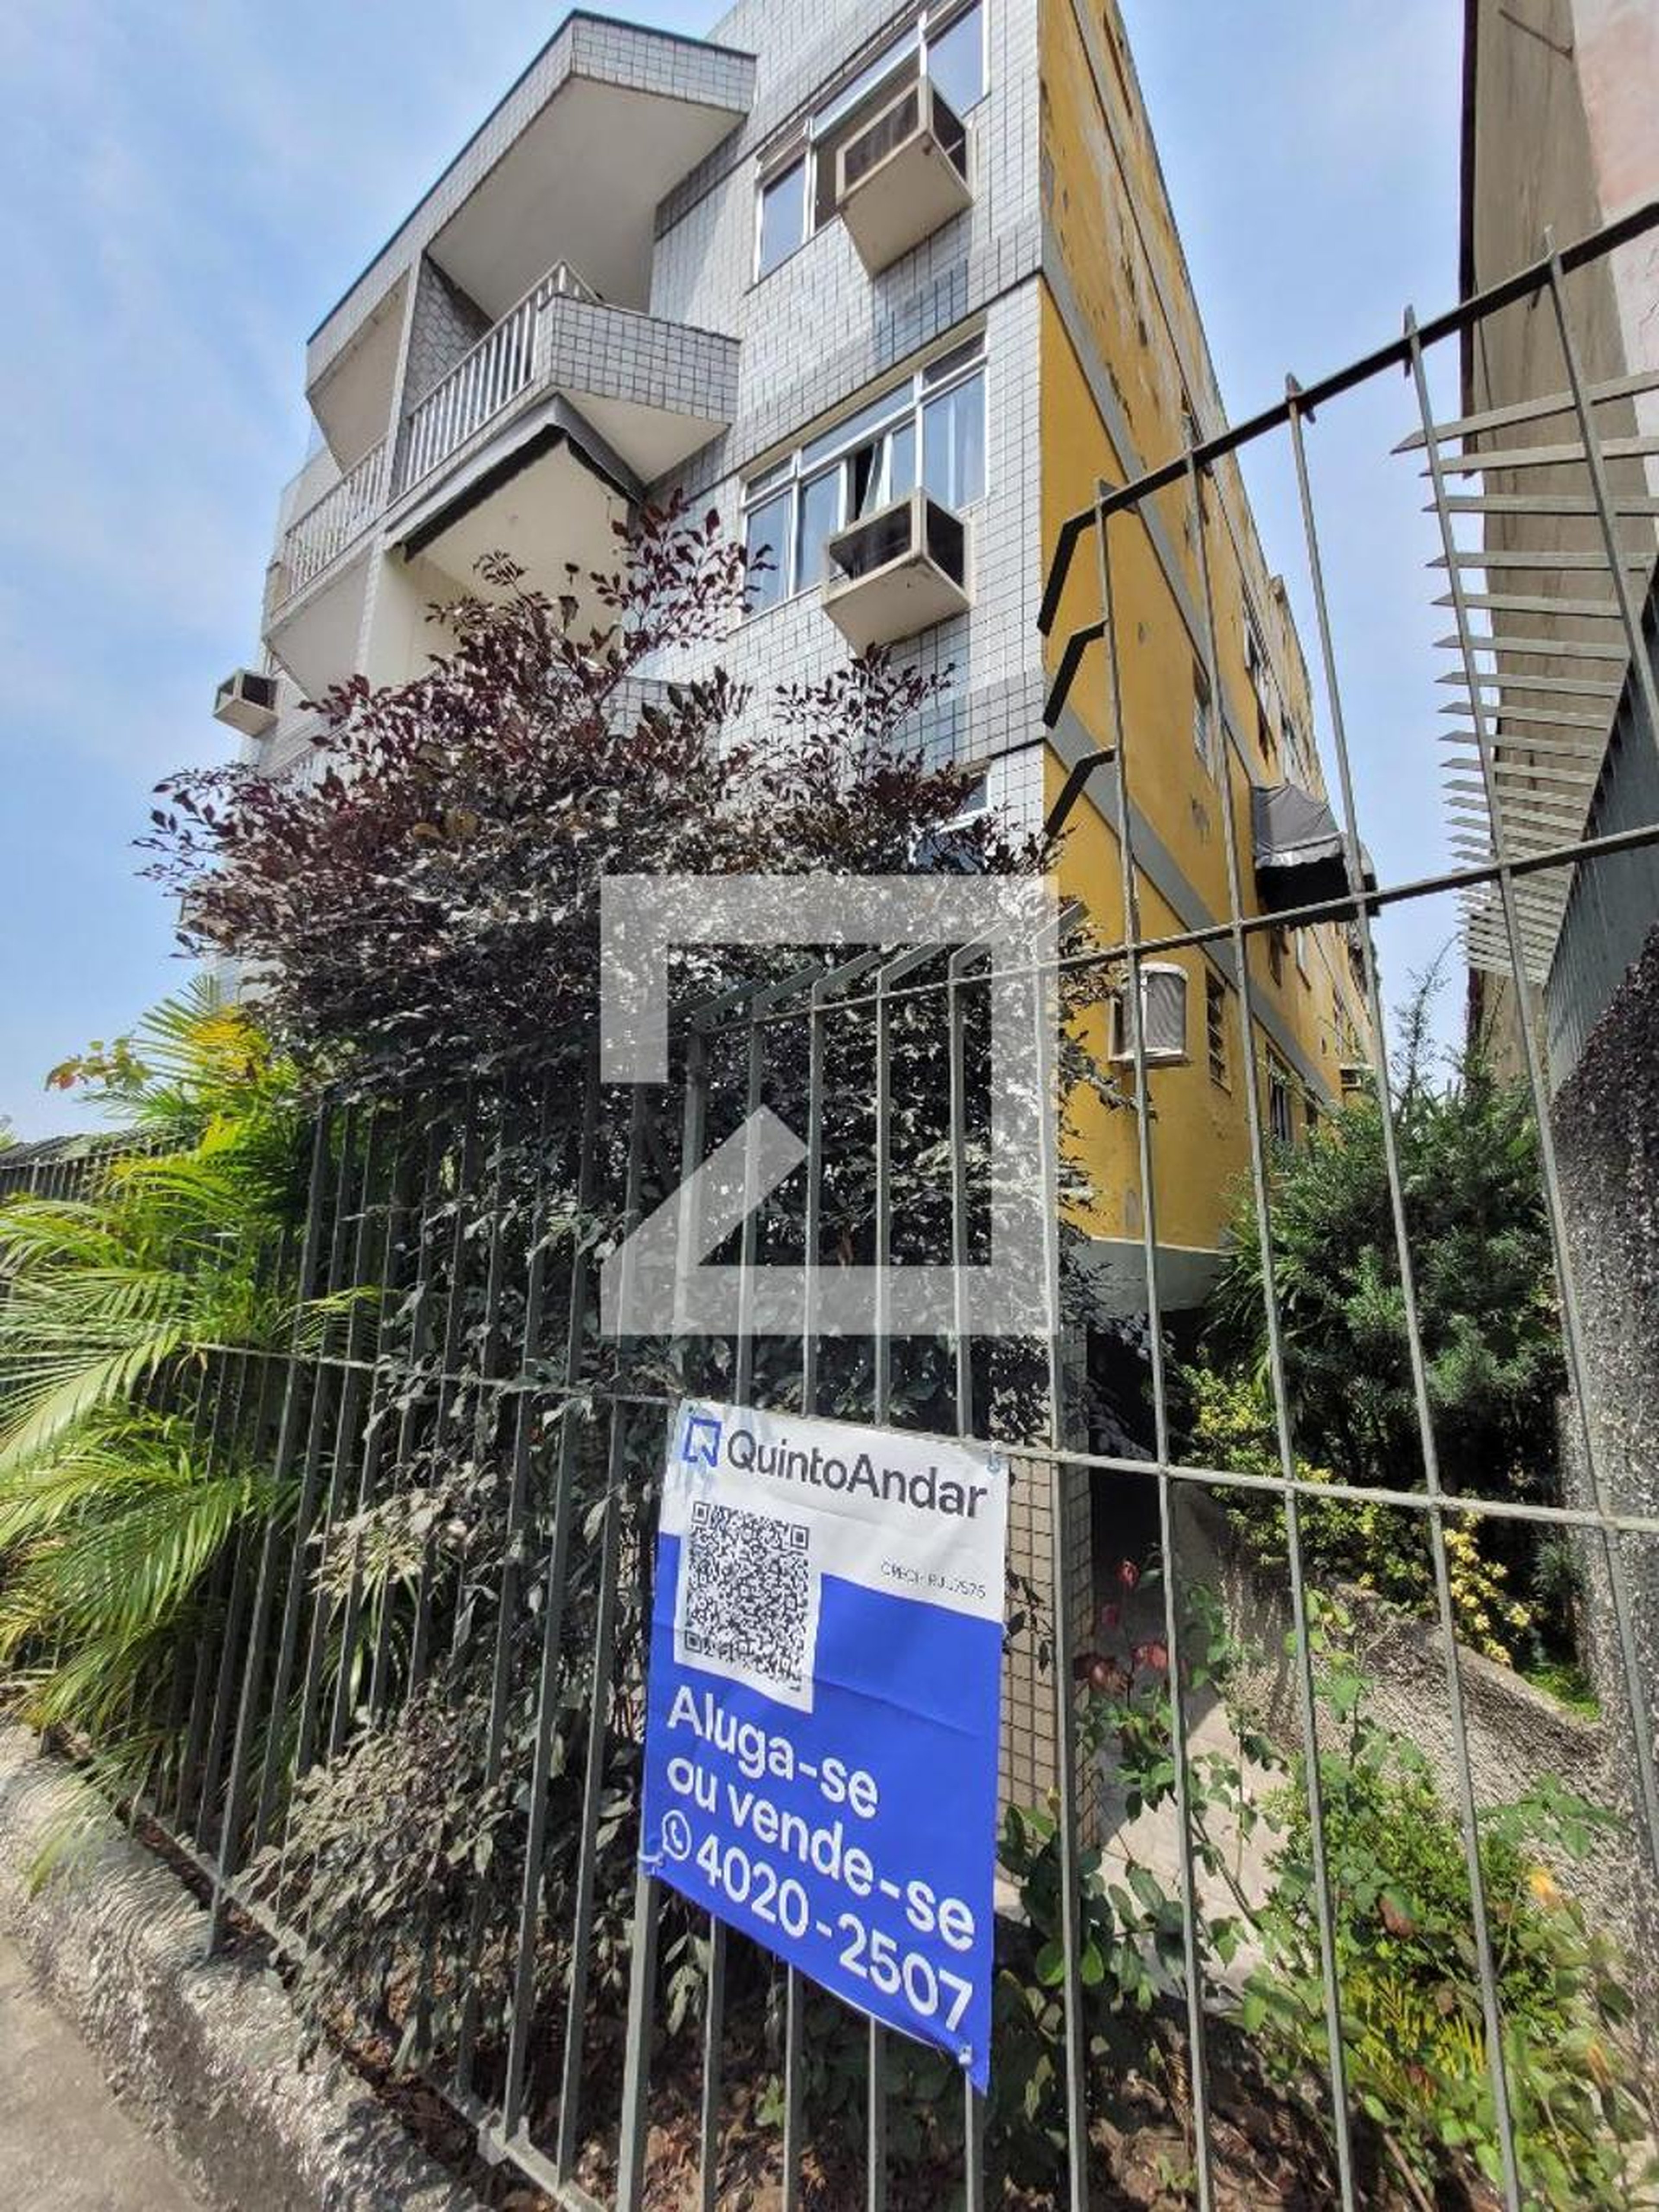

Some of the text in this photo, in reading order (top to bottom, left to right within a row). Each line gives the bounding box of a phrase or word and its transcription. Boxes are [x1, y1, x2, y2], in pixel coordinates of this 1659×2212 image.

[727, 1429, 988, 1518] QuintoAndar
[667, 1686, 878, 1818] Aluga-se
[667, 1757, 975, 1951] ou vende-se
[696, 1834, 973, 2032] 4020-2507
